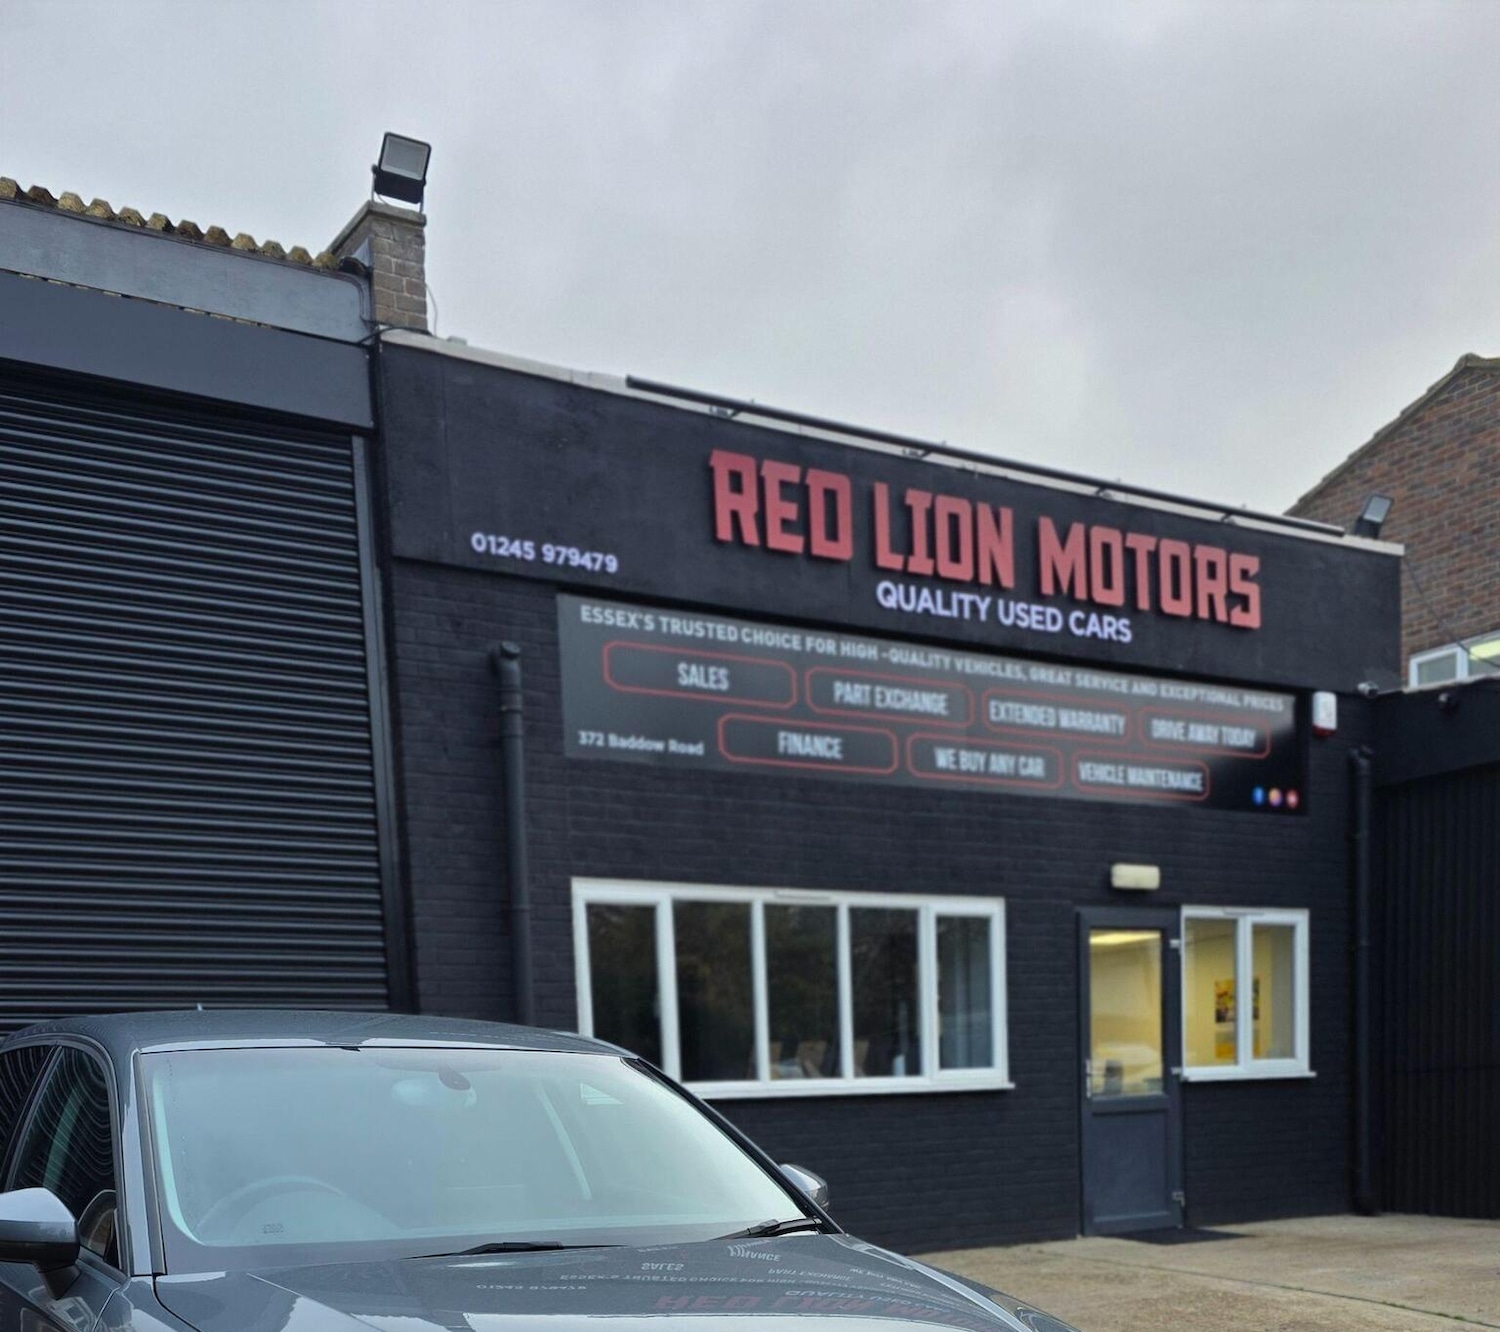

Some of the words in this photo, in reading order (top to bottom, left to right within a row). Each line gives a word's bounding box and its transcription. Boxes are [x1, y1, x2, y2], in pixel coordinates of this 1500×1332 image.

[471, 532, 535, 561] 01245
[541, 544, 618, 573] 979479
[709, 449, 853, 561] RED
[873, 481, 1014, 588] LION
[1038, 516, 1261, 629] MOTORS
[876, 581, 991, 622] QUALITY
[998, 599, 1063, 632] USED
[1069, 610, 1132, 643] CARS
[580, 605, 655, 631] ESSEX'S
[659, 616, 738, 641] TRUSTED
[741, 627, 801, 650] CHOICE
[805, 636, 837, 656] FOR
[840, 641, 878, 661] HIGH
[955, 657, 1026, 681] VEHICLES,
[1030, 666, 1072, 685] GREAT
[1075, 673, 1129, 694] SERVICE
[1132, 679, 1157, 697] AND
[1160, 683, 1241, 707] EXCEPTIONAL
[1244, 693, 1285, 712] PRICES
[677, 662, 729, 690] SALES
[833, 680, 872, 704] PART
[875, 686, 948, 715] EXCHANGE
[989, 700, 1057, 727] EXTENDED
[1058, 709, 1126, 735] WARRANTY
[1152, 718, 1186, 740] DRIVE
[1188, 724, 1220, 744] AWAY
[1221, 726, 1256, 748] TODAY
[578, 730, 605, 748] 372
[608, 733, 665, 753] Baddow
[668, 738, 705, 756] Road
[777, 731, 843, 759] FINANCE
[934, 747, 957, 771] WE
[959, 750, 987, 773] BUY
[988, 753, 1016, 775] ANY
[1018, 756, 1045, 778] CAR
[1078, 762, 1125, 785] VEHICLE
[1127, 767, 1203, 791] MAINTENANCE
